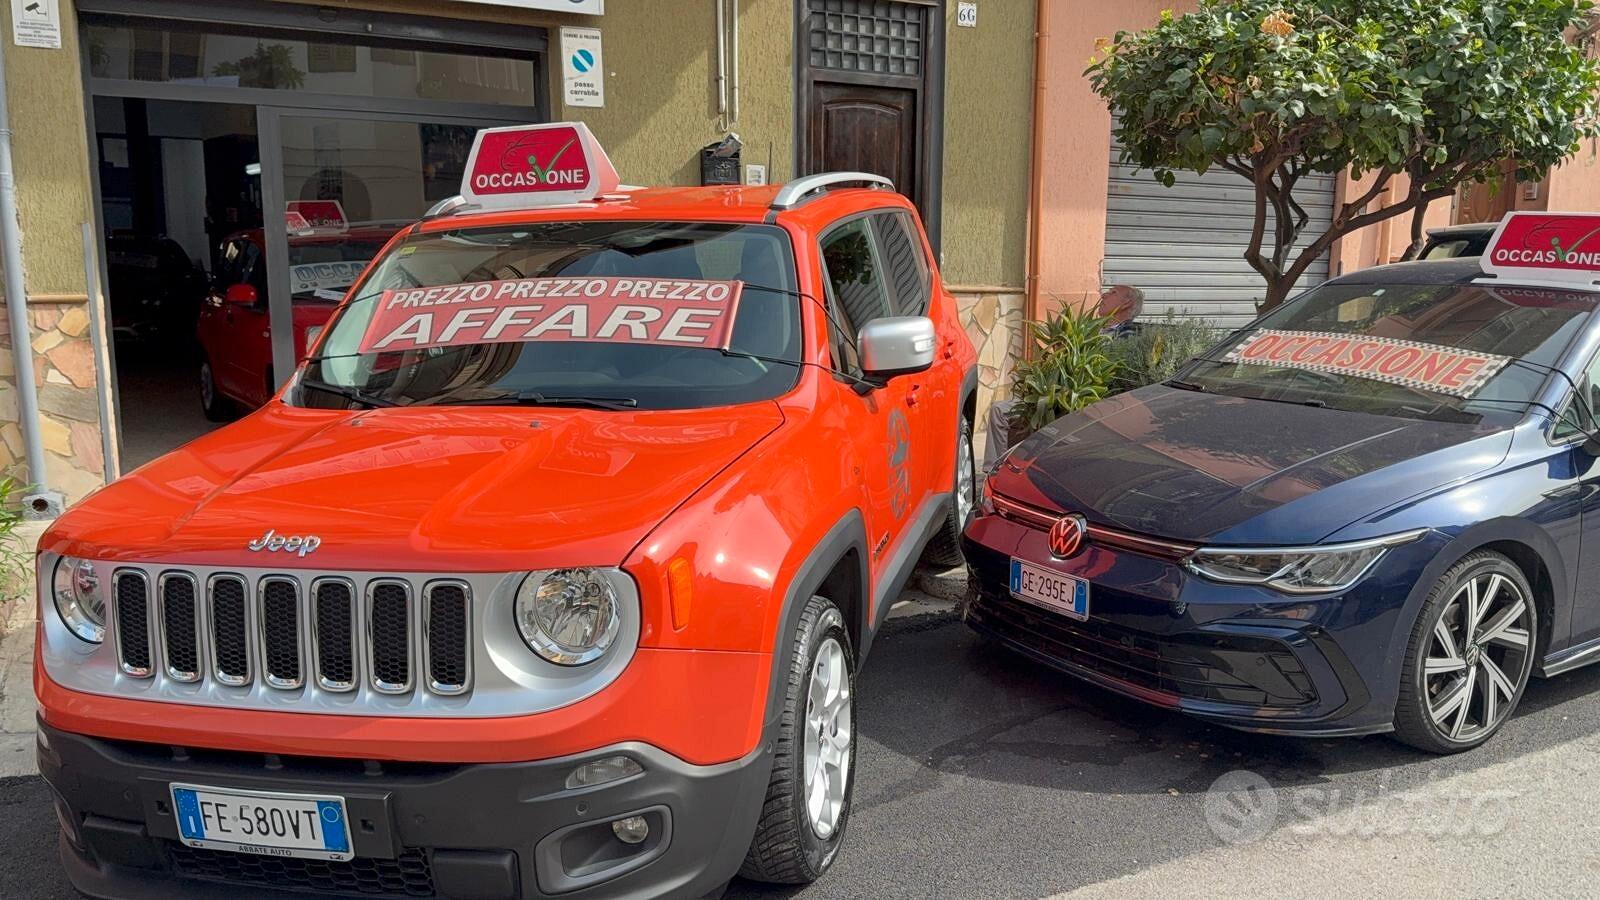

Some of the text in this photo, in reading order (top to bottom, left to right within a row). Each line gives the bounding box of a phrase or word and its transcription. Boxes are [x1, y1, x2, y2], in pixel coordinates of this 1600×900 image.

[959, 8, 975, 22] 6G
[569, 89, 599, 97] carrabile
[386, 279, 730, 310] PREZZO PREZZO PREZZO
[372, 303, 724, 349] AFFARE
[1241, 335, 1488, 388] OCCASIONE
[248, 529, 321, 557] Jeep
[270, 848, 292, 856] AUTO
